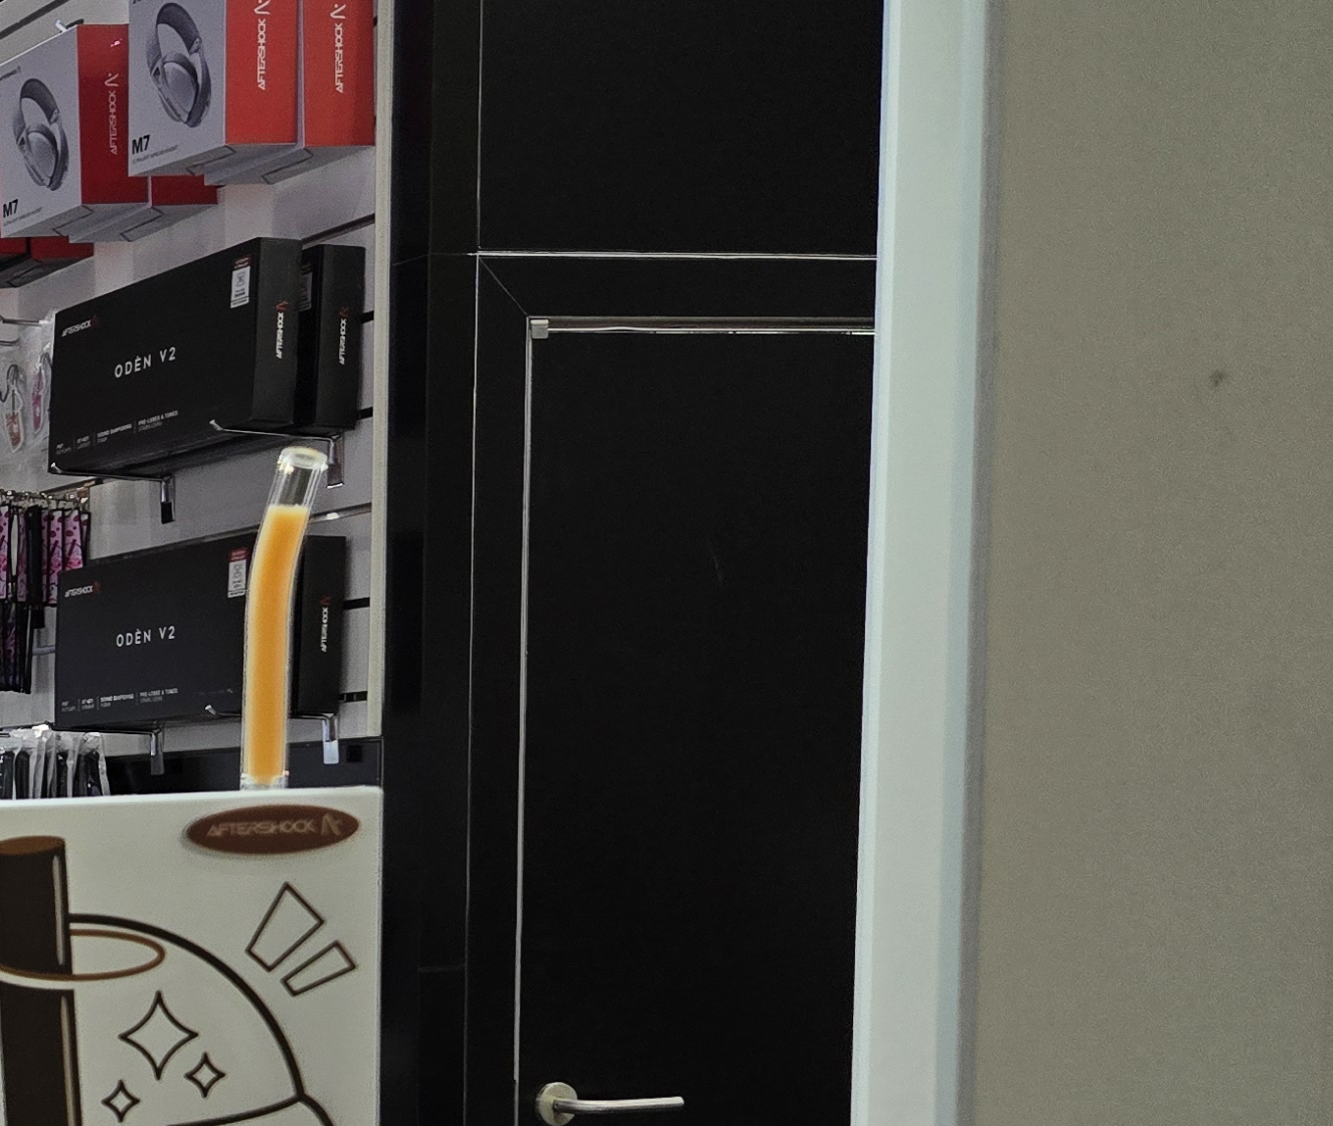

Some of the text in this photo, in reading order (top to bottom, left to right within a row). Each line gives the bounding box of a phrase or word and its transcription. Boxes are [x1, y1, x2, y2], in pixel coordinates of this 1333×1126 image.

[256, 18, 267, 91] AFTERSHOCK
[334, 22, 345, 94] AFTERSHOCK
[108, 90, 118, 156] AFTERSHOCK
[130, 134, 151, 156] M7
[2, 199, 19, 219] M7
[159, 346, 177, 363] V2
[158, 625, 176, 640] V2
[207, 818, 315, 838] AFTERSHOCK
